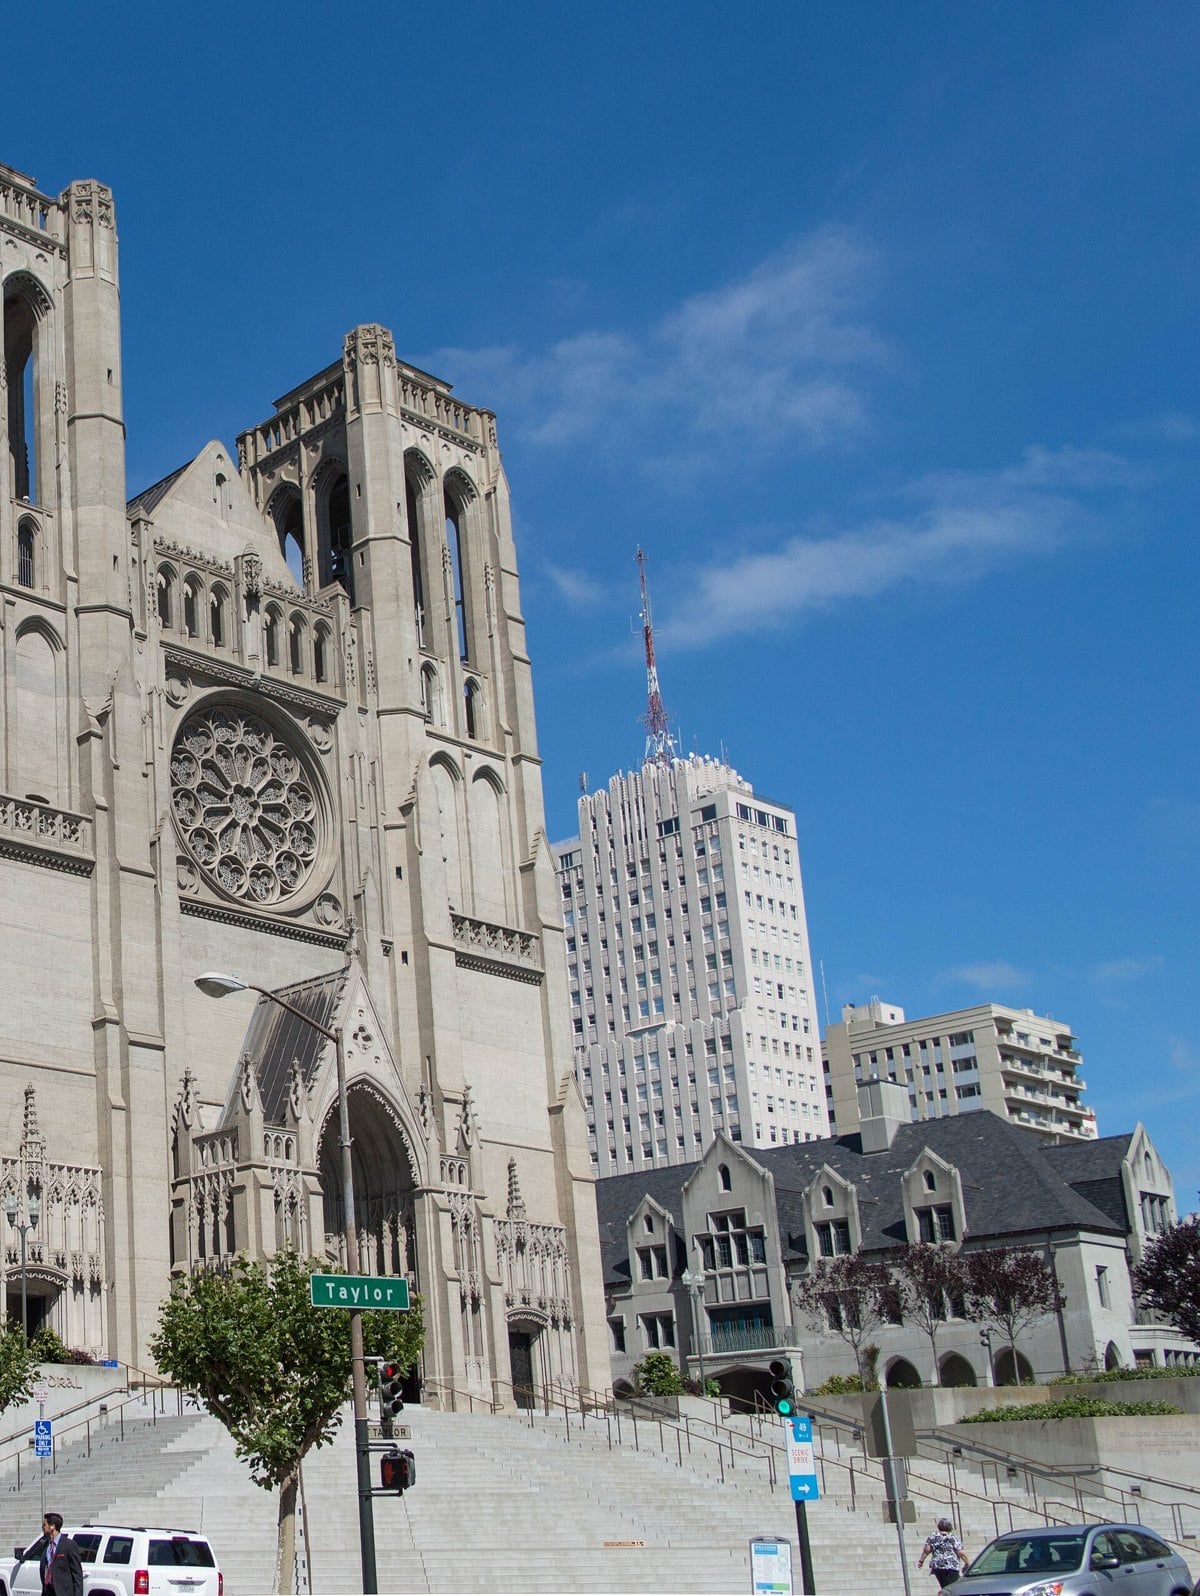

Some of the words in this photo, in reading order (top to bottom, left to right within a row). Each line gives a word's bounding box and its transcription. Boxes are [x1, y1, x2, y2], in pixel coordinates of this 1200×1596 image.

[325, 1282, 393, 1304] Taylor
[372, 1427, 407, 1438] TAYLOR
[791, 1448, 809, 1456] SCENIC
[793, 1456, 809, 1464] DRIVE
